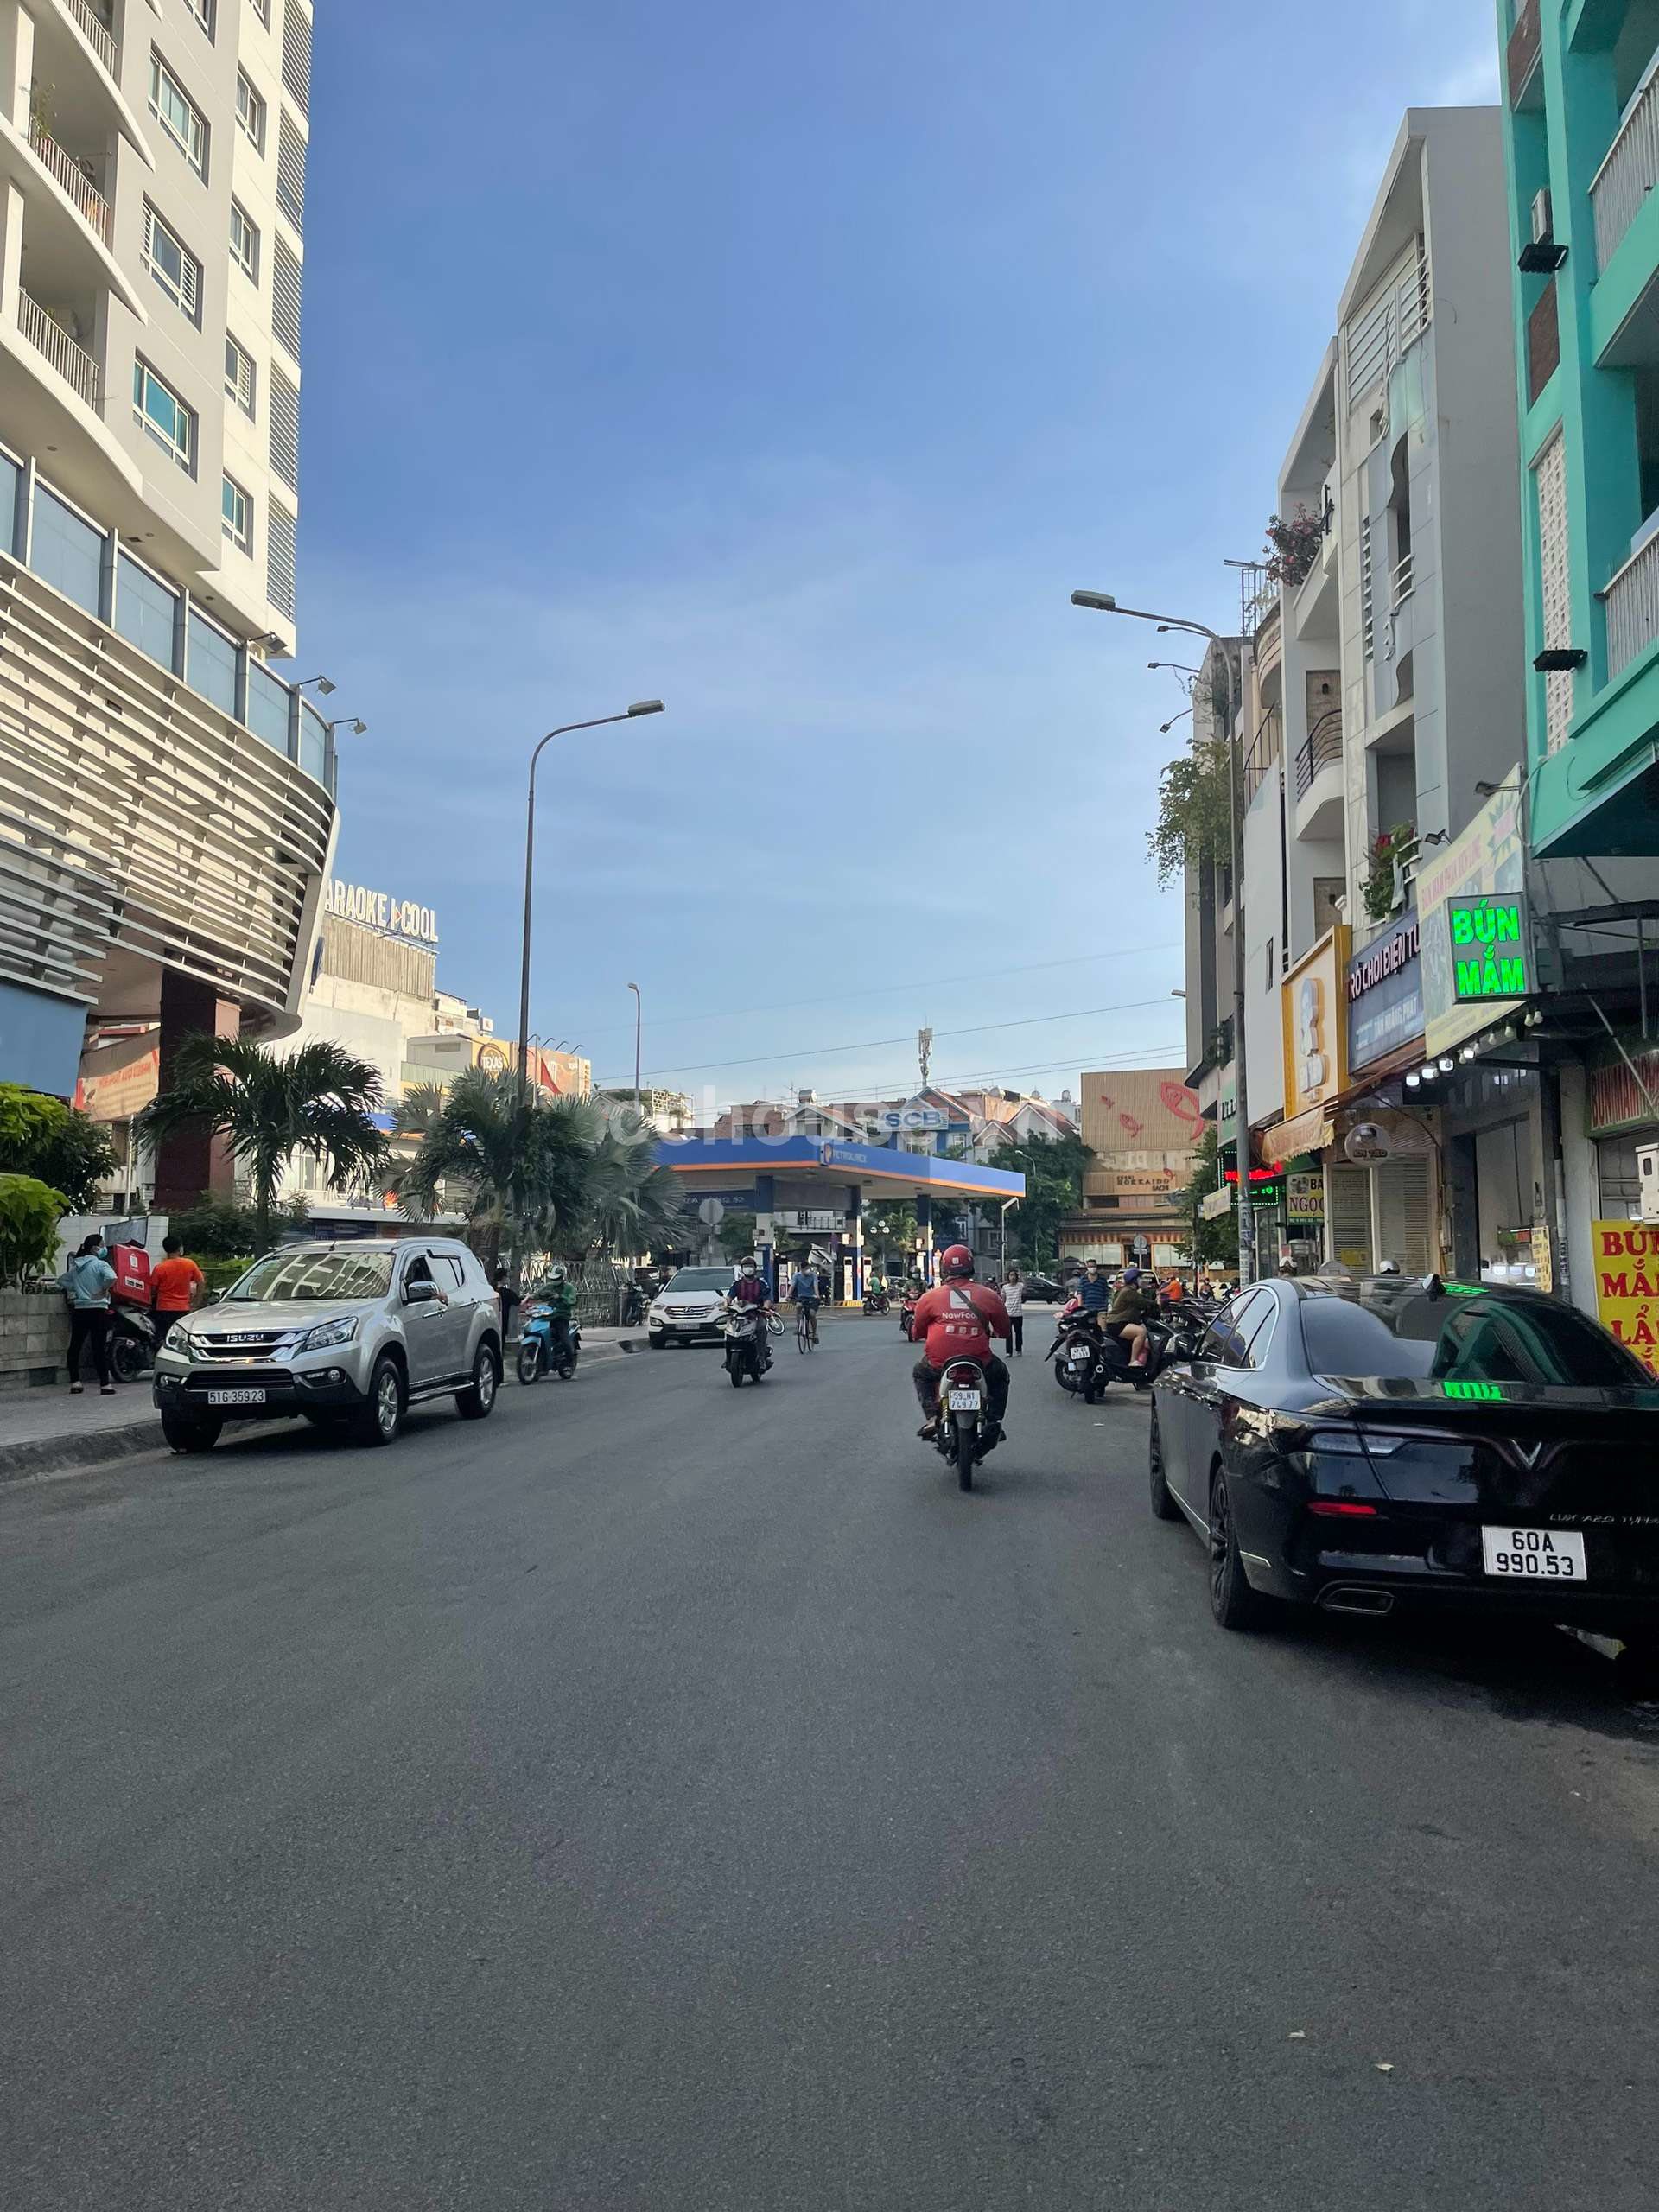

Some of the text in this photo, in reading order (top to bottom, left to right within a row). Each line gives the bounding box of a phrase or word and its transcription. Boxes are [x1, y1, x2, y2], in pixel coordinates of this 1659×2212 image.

[325, 878, 388, 926] ARAOKE
[1452, 899, 1521, 945] BÚN
[1349, 962, 1362, 1001] RÒ
[1456, 944, 1526, 995] MẮM
[481, 1056, 503, 1069] TEXAS
[885, 1111, 942, 1128] SCB
[1601, 1258, 1659, 1298] MẮ
[942, 1312, 978, 1320] NowFoo
[1611, 1304, 1659, 1345] LẨ
[226, 1334, 264, 1343] ISUZU
[1512, 1530, 1554, 1552] 60A
[1497, 1553, 1574, 1576] 990.53
